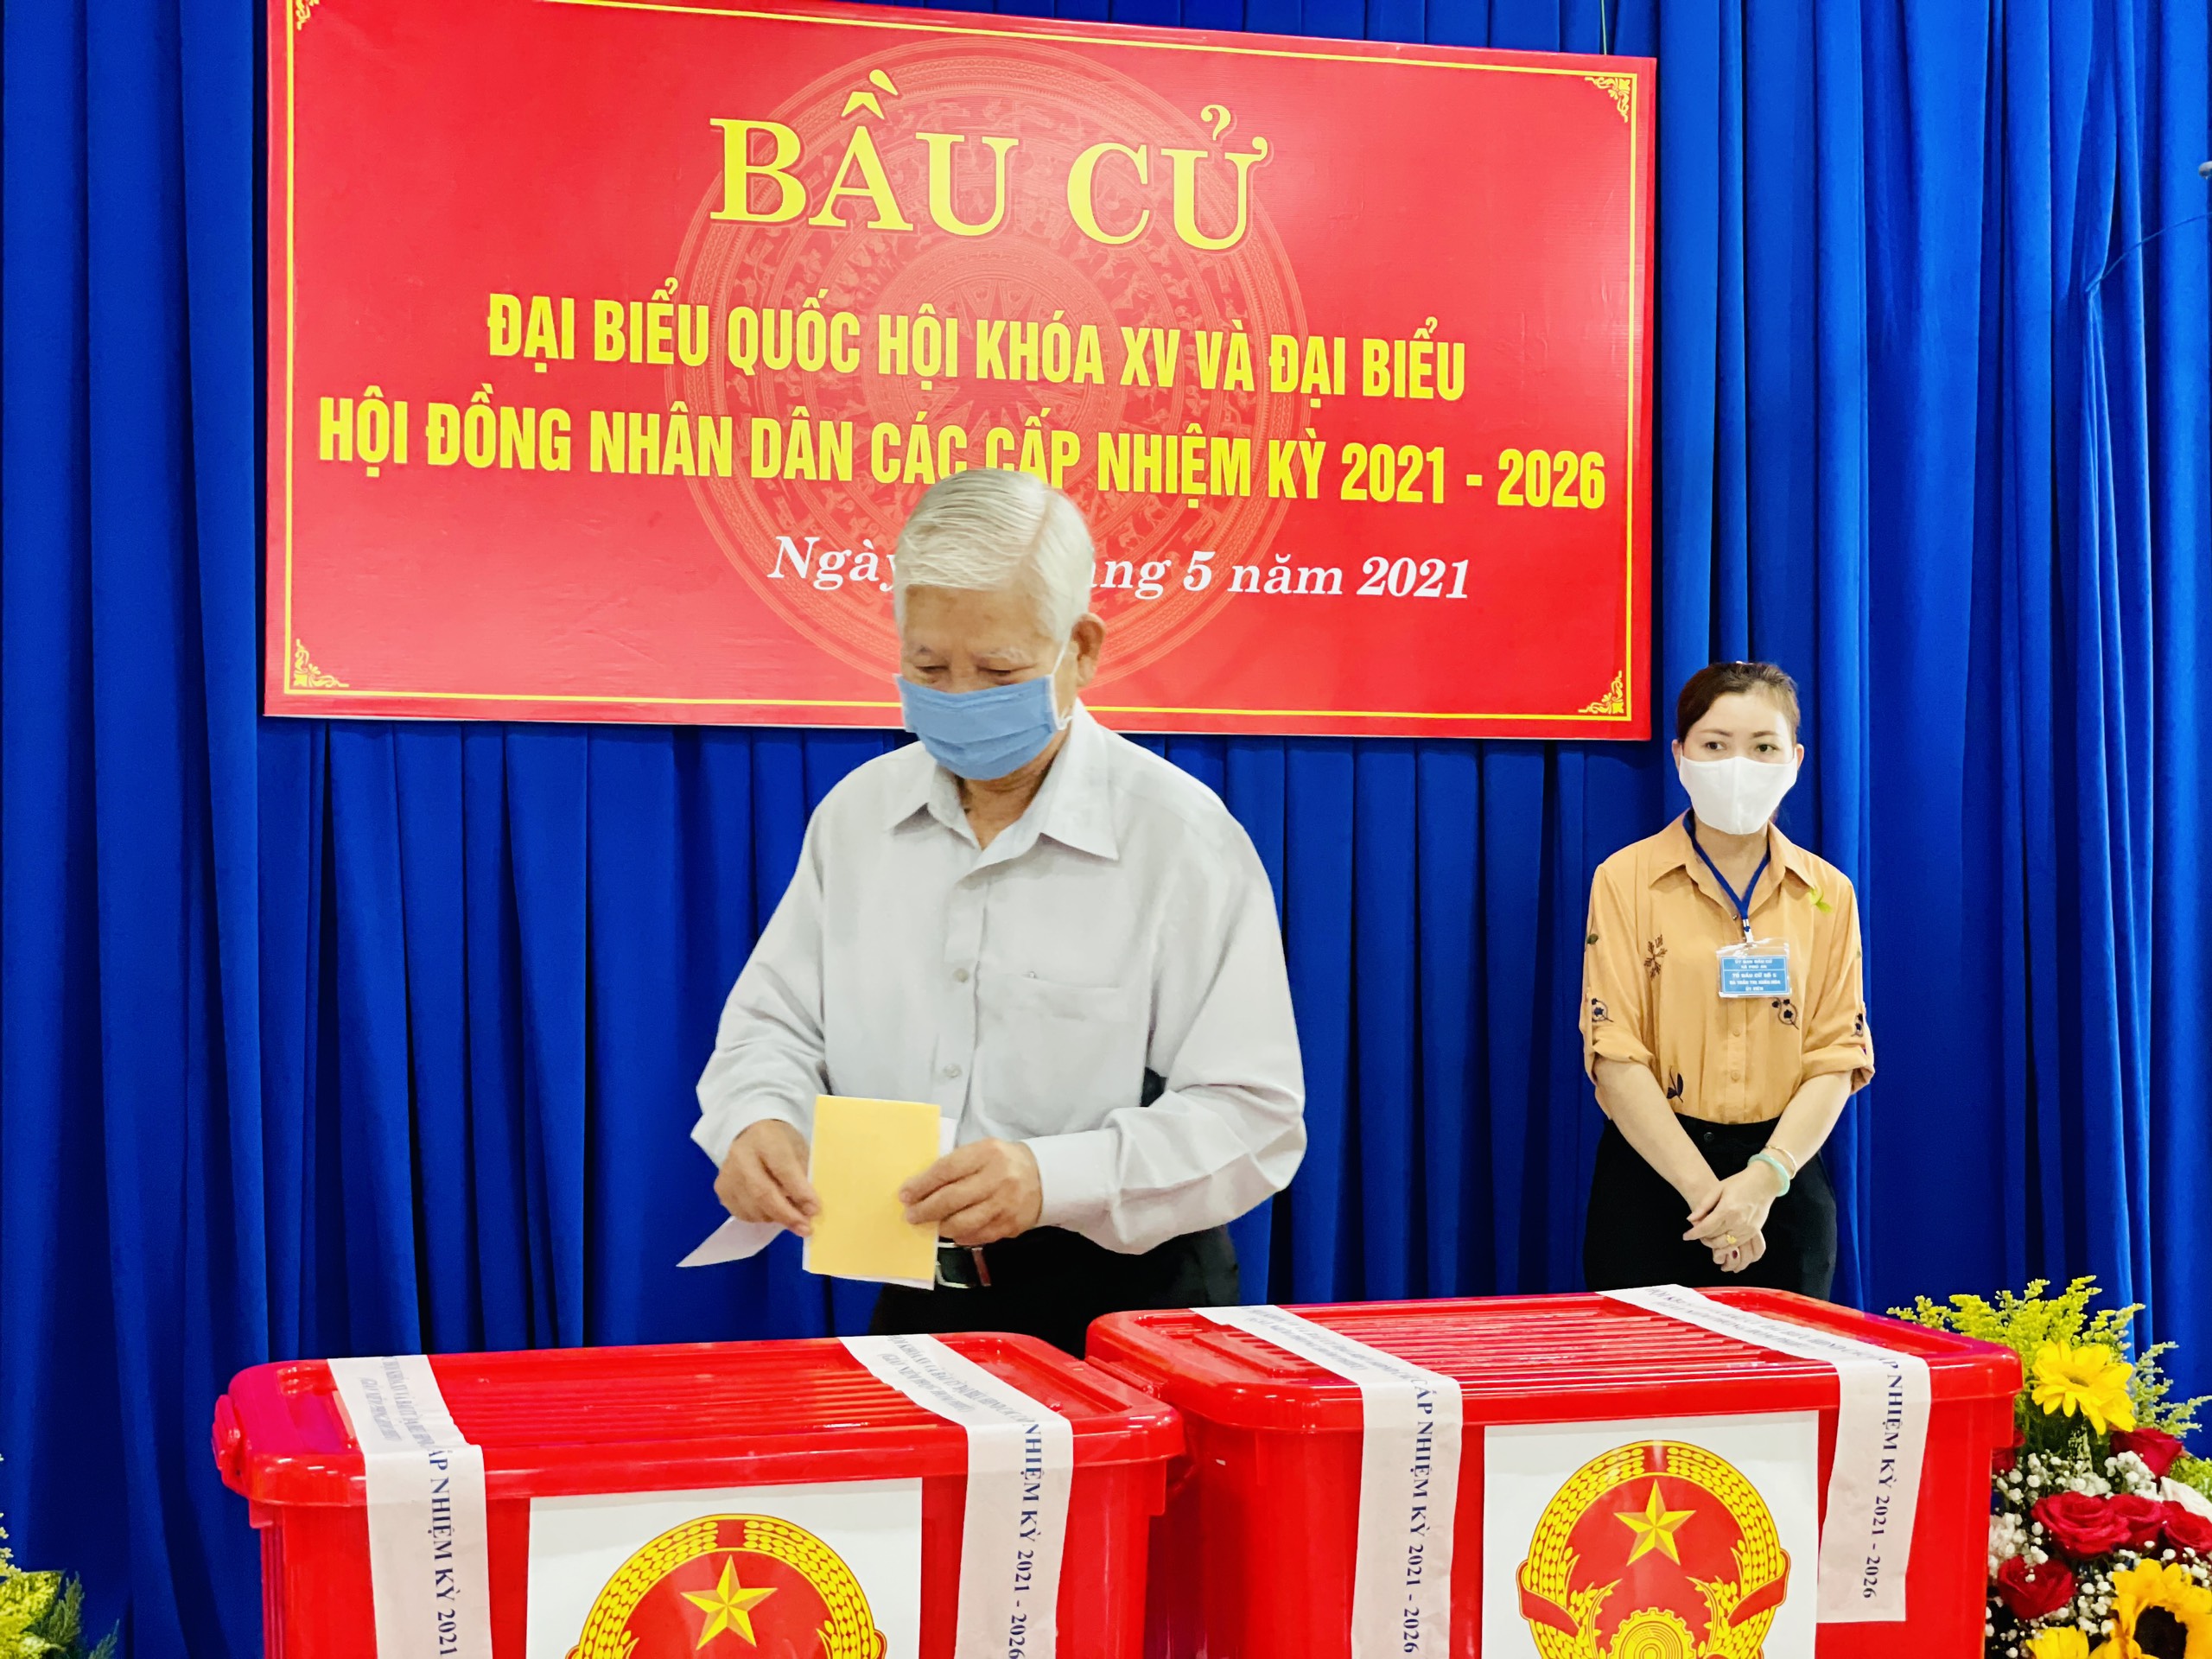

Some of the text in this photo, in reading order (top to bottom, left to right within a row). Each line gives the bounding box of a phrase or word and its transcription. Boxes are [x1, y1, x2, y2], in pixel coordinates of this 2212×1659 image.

[709, 69, 1268, 251] BẦU CỬ
[487, 277, 1465, 408] ĐẠI BIỂU QUỐC HỘI KHÓA XV VÀ ĐẠI BIỂU
[320, 384, 1605, 509] HỘI ĐỒNG NHÂN DÂN CÁC CẤP NHIỆM KỲ 2021 - 2026
[1183, 550, 1216, 592] 5
[1227, 554, 1343, 594] năm
[1357, 556, 1470, 599] 2021
[1882, 1374, 1904, 1450] NHIỆM
[1020, 1423, 1045, 1502] NHIỆM
[1409, 1421, 1433, 1498] NHIỆM
[1878, 1458, 1897, 1490] KỲ
[427, 1477, 455, 1560] NHIỆM
[1019, 1510, 1041, 1542] KỲ
[1409, 1505, 1431, 1537] KỲ
[1871, 1495, 1891, 1536] 2021
[435, 1567, 461, 1601] KỲ
[1014, 1549, 1034, 1592] 2021
[1406, 1543, 1424, 1586] 2021
[1863, 1555, 1882, 1599] 2026
[437, 1608, 458, 1656] 2021
[1007, 1613, 1027, 1659] 2026
[1402, 1607, 1420, 1654] 2026
